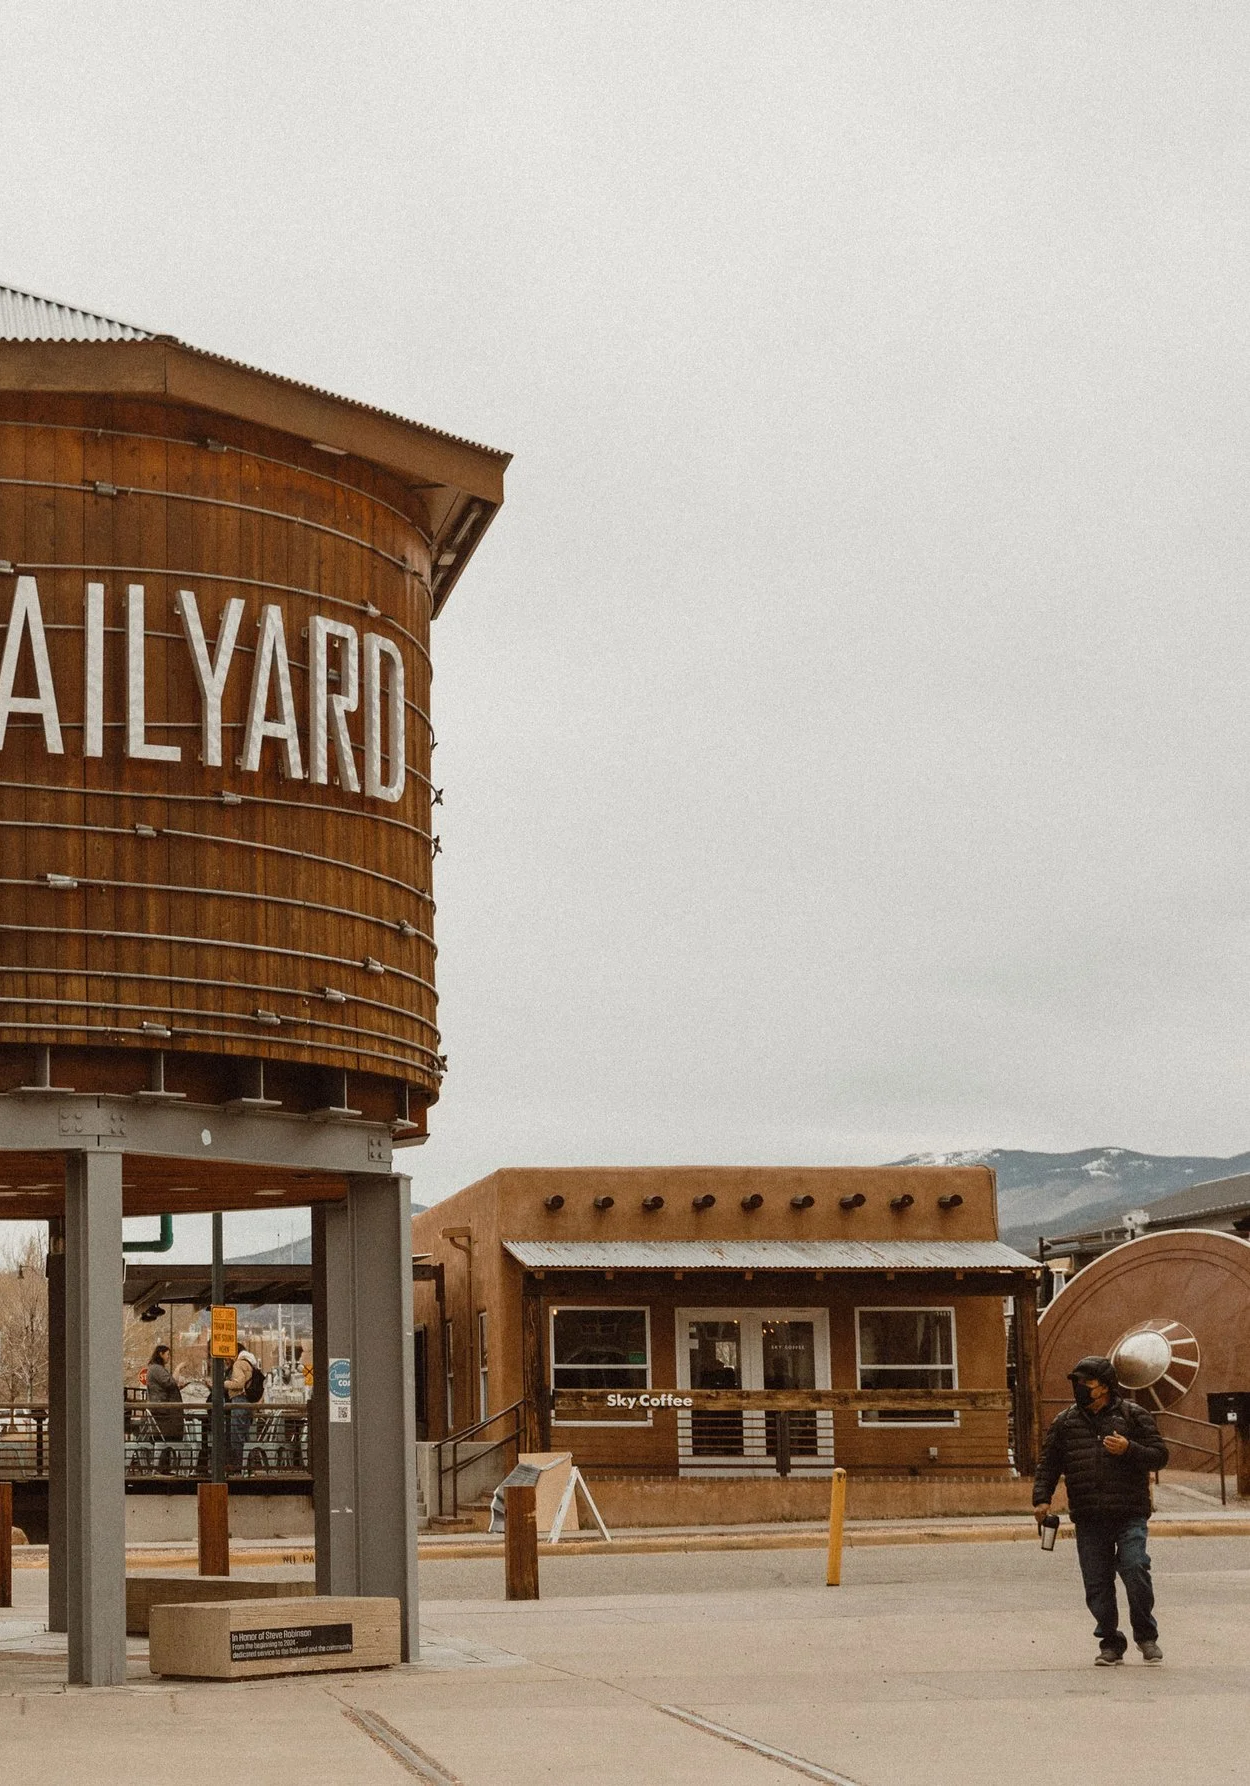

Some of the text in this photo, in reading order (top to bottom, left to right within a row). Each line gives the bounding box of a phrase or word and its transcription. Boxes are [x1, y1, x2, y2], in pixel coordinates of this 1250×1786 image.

[607, 1393, 693, 1409] Sky Coffee
[231, 1629, 311, 1642] In Honor of Steve Robinson
[254, 1641, 277, 1649] beginning
[232, 1650, 257, 1659] dedicated
[257, 1649, 275, 1657] service
